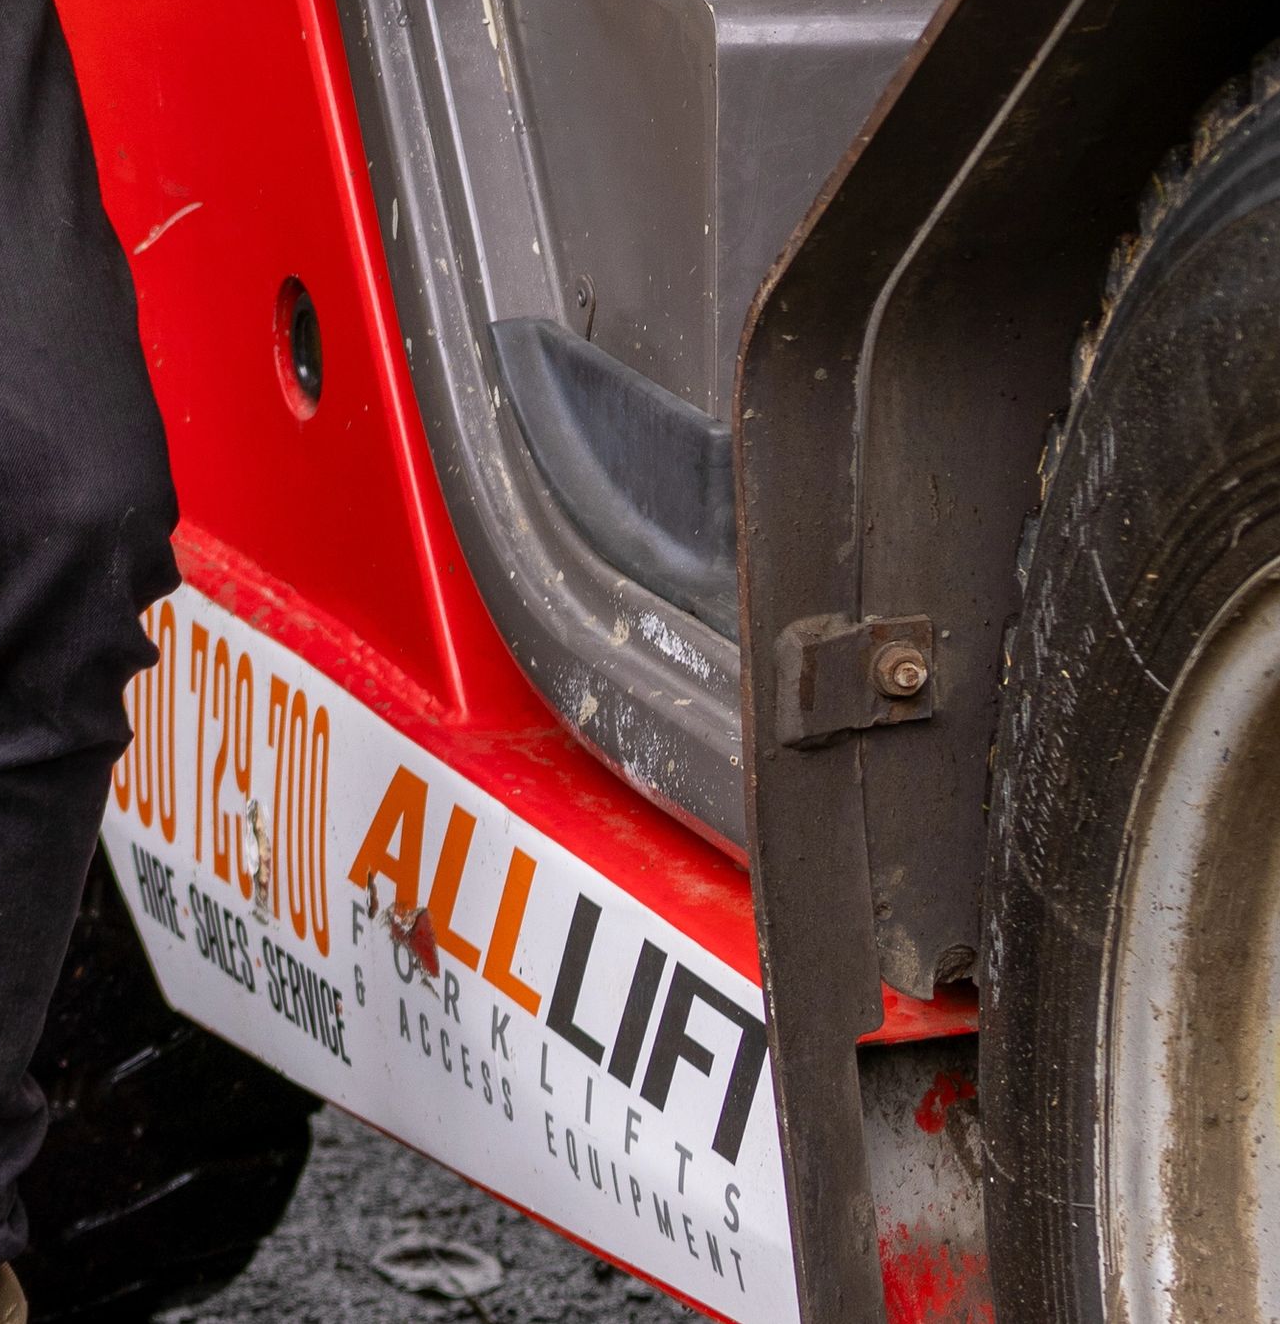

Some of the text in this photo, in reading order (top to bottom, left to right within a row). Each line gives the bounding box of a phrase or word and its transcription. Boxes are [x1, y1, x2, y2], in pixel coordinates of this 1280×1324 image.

[113, 599, 331, 959] 00 729 700
[131, 841, 353, 1069] HIRE SALES SERVICE
[399, 996, 514, 1123] ACCESS
[544, 1111, 746, 1293] EQUIPMENT
